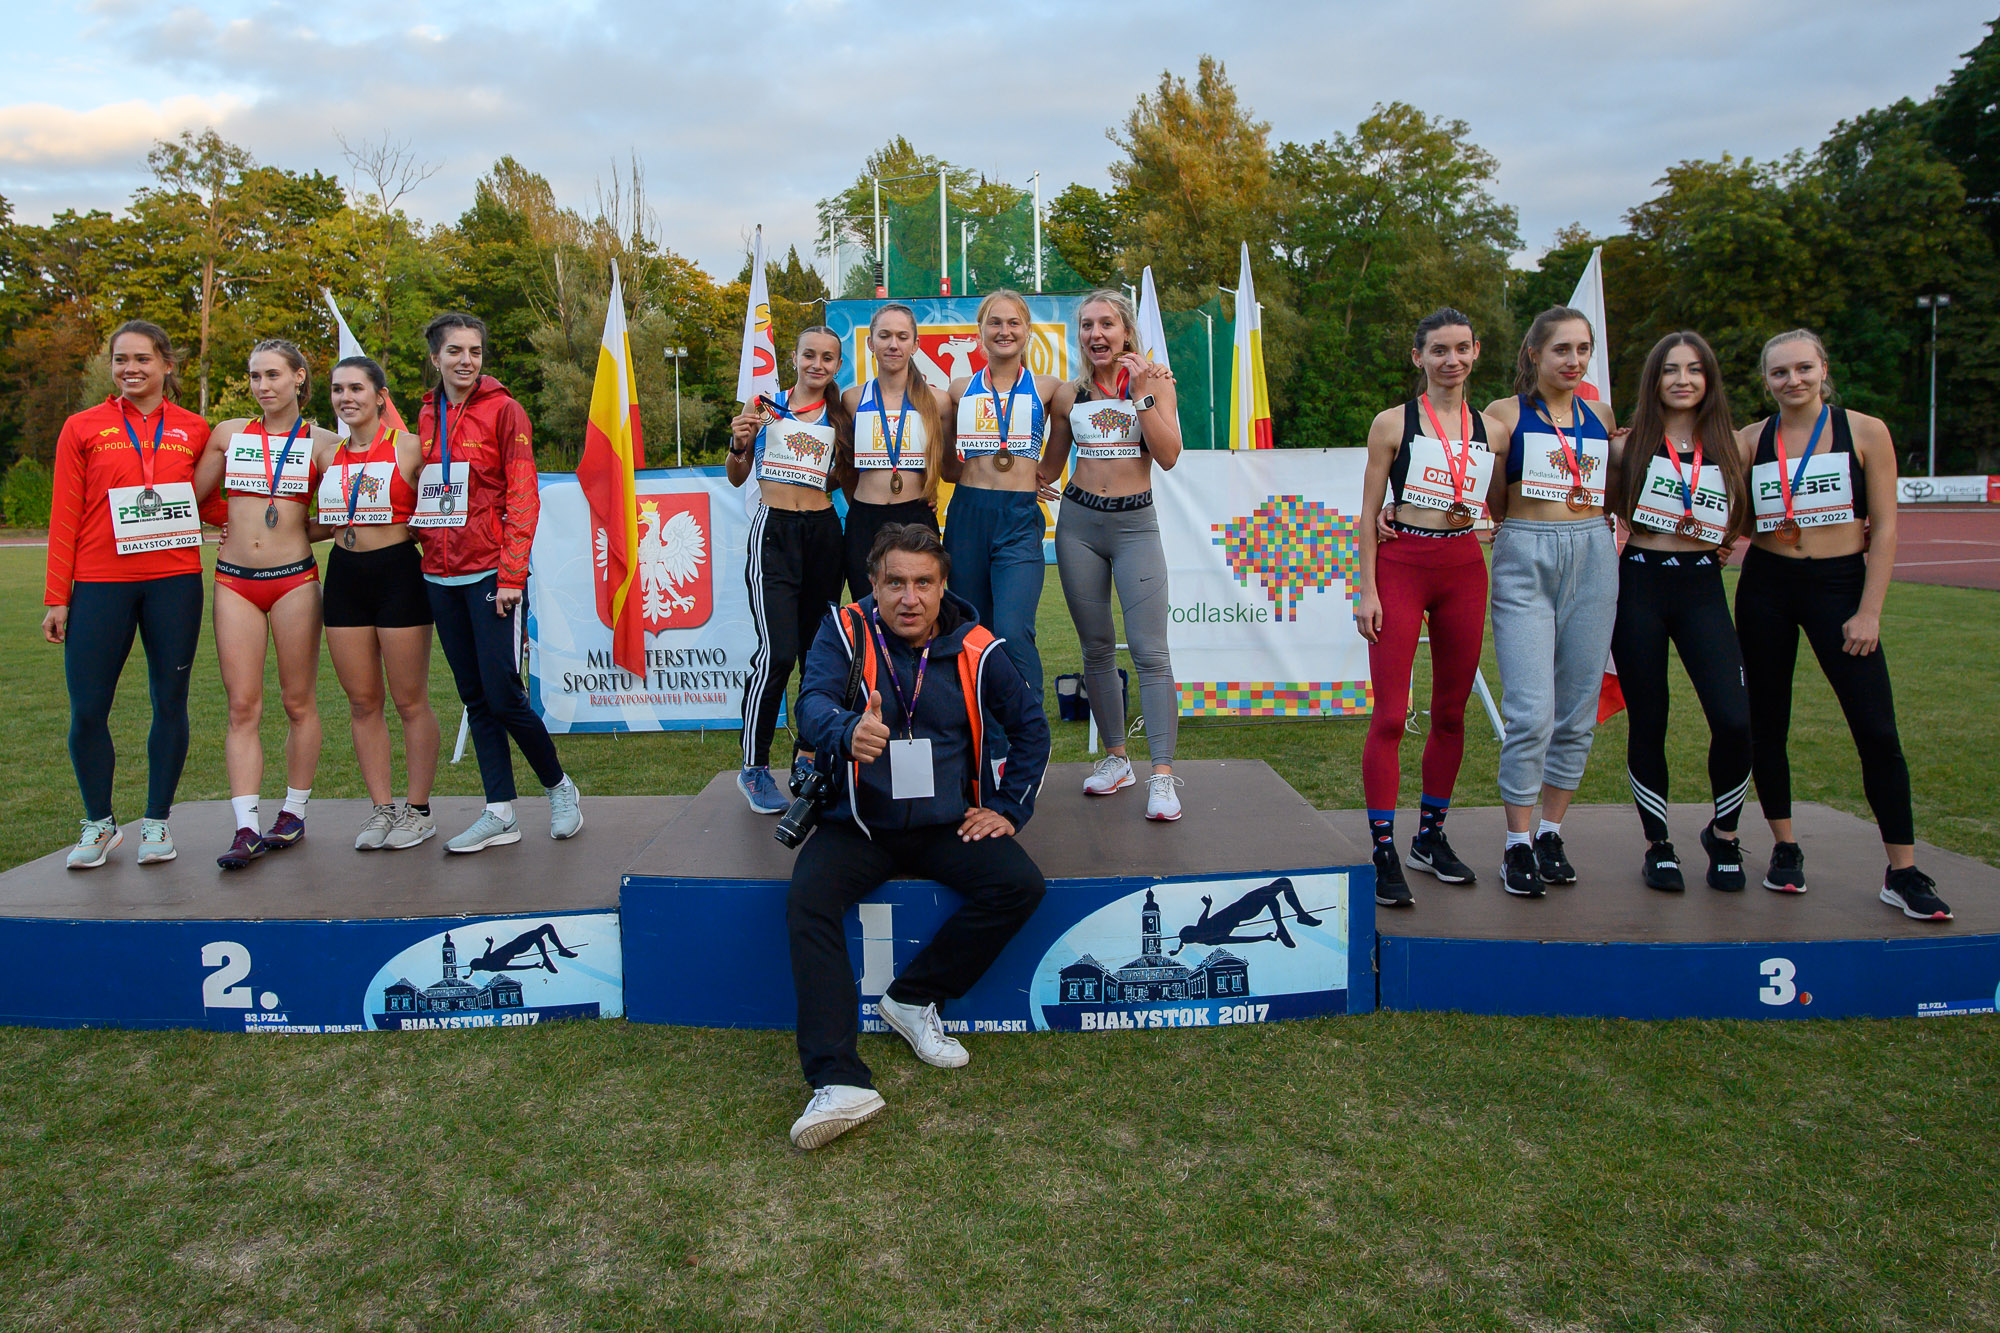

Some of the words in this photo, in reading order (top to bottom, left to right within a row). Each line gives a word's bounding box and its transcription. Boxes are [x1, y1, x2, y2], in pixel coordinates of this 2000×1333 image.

[977, 420, 1011, 430] PZL
[104, 440, 149, 451] PODLAIE
[151, 441, 195, 457] AŁYSTOK
[1008, 441, 1027, 449] 2022
[1117, 448, 1137, 456] 2022
[765, 468, 807, 480] BIAŁYSTOK
[808, 475, 823, 485] 2022
[1426, 469, 1473, 490] ORLN
[1529, 469, 1560, 479] Podlaskie
[230, 479, 279, 489] BIAŁYST
[282, 482, 304, 490] 2022
[1078, 491, 1120, 510] NIKE
[1122, 490, 1152, 509] PRO
[1526, 487, 1568, 500] BIAŁYSTO
[323, 514, 367, 522] BIAŁYSOK
[1762, 515, 1818, 529] BIATOK
[1821, 512, 1847, 522] 2022
[1639, 512, 1692, 533] BIAŁYSTK
[1700, 529, 1719, 540] 022
[122, 539, 174, 552] BIAŁYSTOK
[175, 536, 198, 546] 2022
[587, 647, 728, 669] MITERSTWO
[563, 672, 634, 693] SPORTU
[848, 657, 862, 698] OLYMPUS
[590, 694, 682, 706] RZECZYPOSPOLITEJ
[684, 692, 727, 704] POLSKIEJ
[1656, 861, 1678, 869] PUMA
[1718, 864, 1740, 872] PUMA
[400, 1014, 495, 1031] BIAŁYSTOK
[501, 1012, 540, 1027] 2017
[1080, 1007, 1210, 1030] BIAŁYSTOK
[1218, 1003, 1270, 1025] 2017
[324, 1024, 363, 1033] POLSKI
[974, 1020, 1027, 1032] POLSKI
